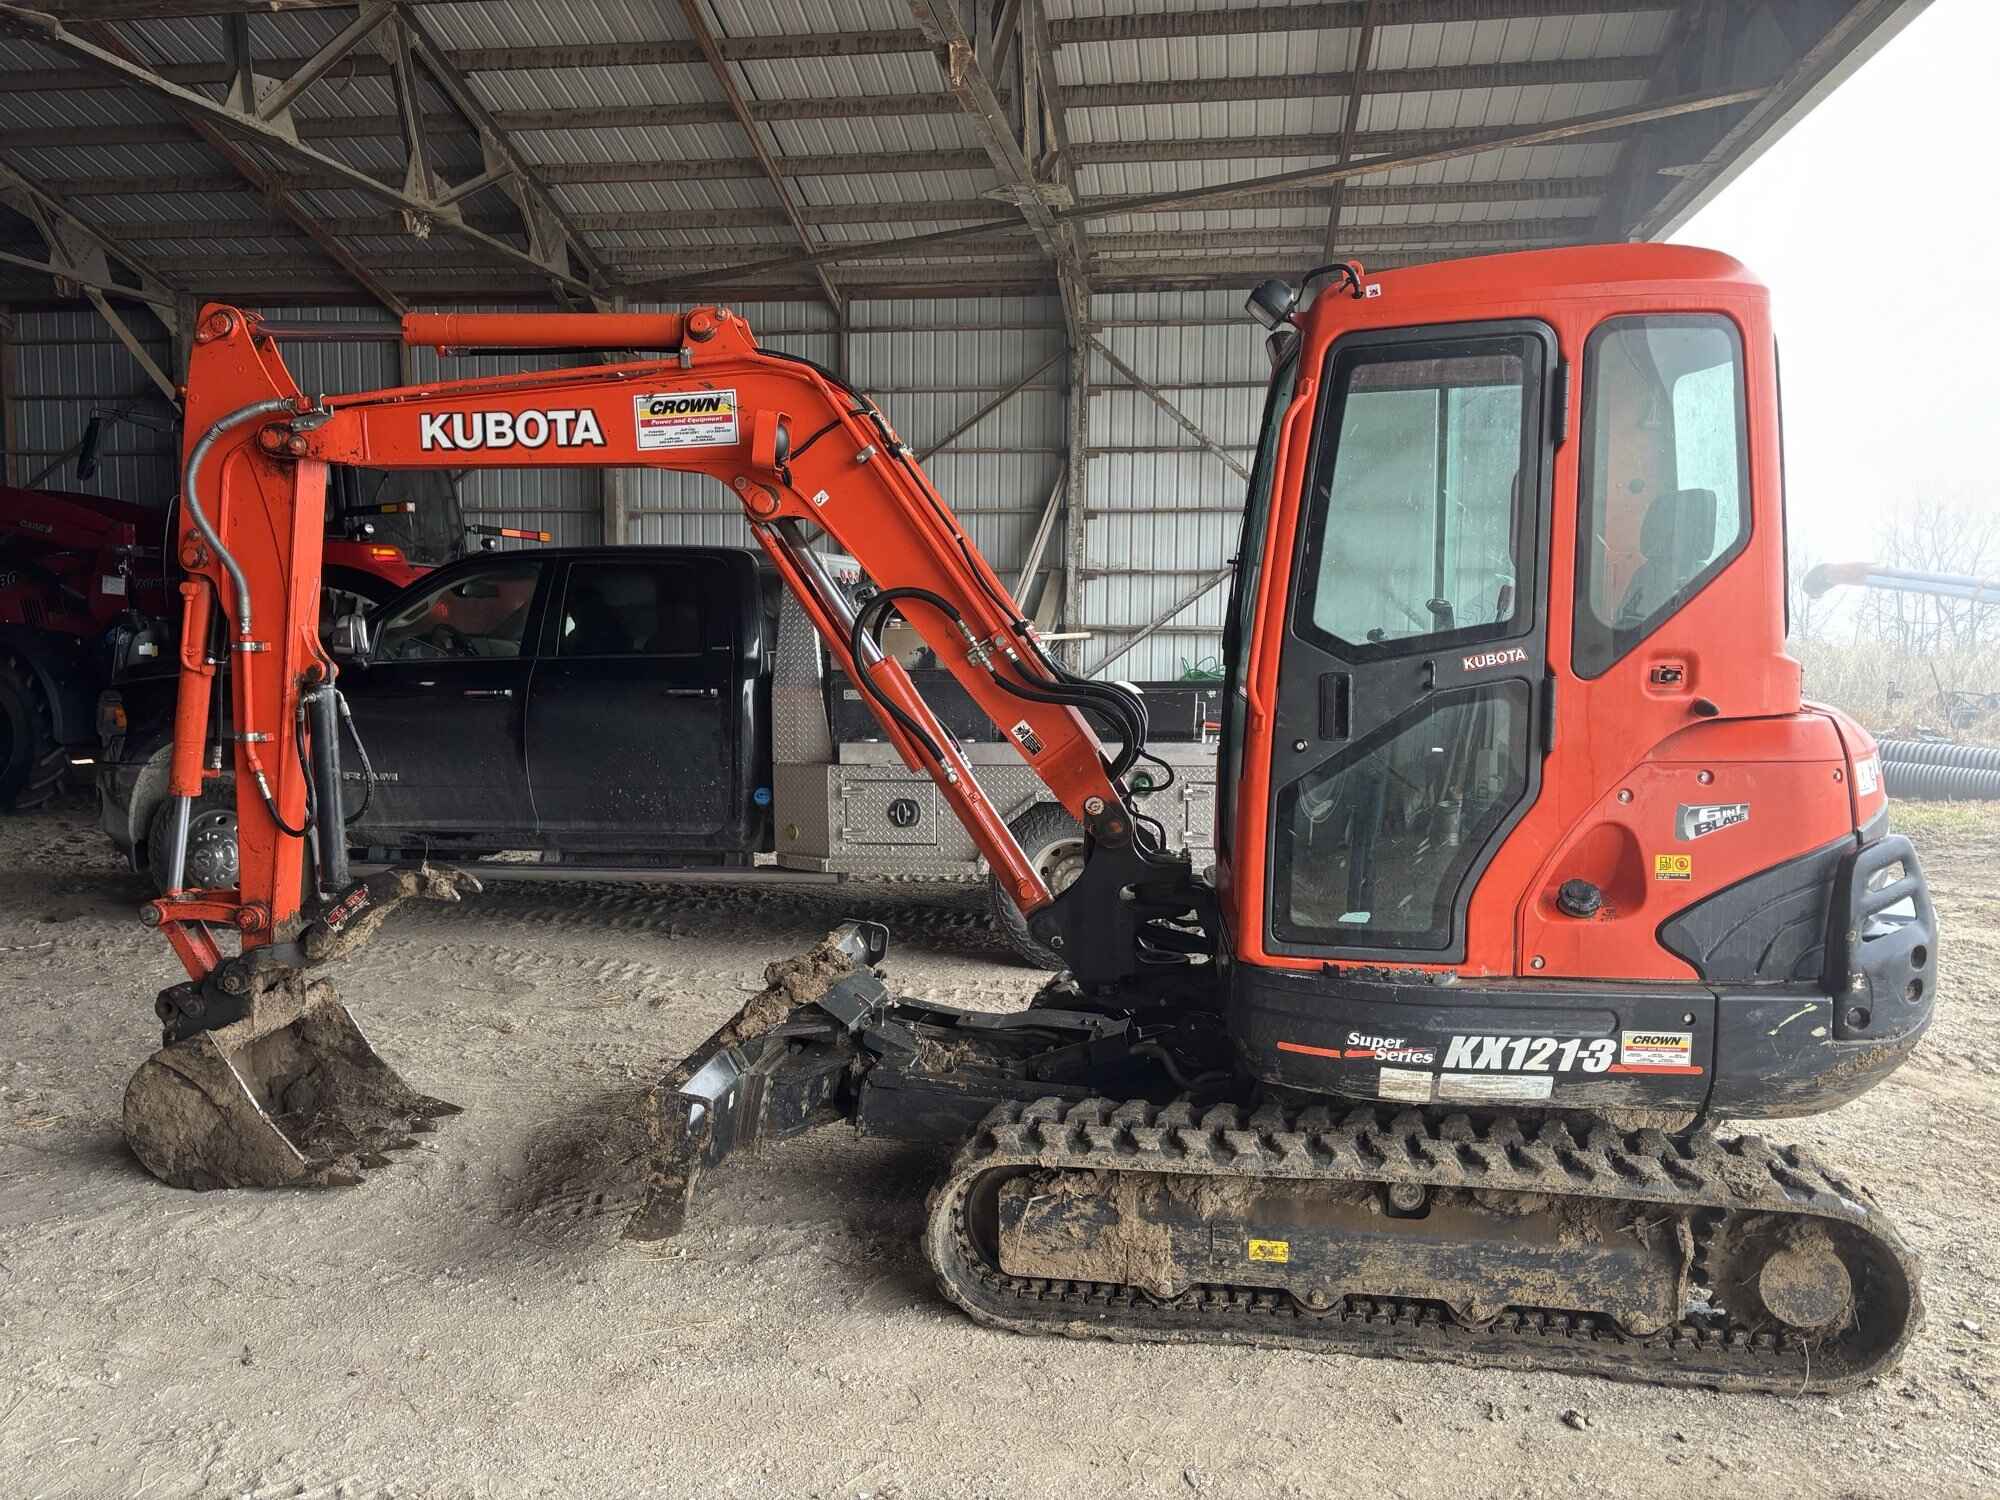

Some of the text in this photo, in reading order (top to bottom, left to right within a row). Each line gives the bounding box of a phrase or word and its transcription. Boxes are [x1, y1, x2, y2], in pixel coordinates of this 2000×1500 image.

[649, 397, 721, 416] CROWN
[419, 408, 606, 450] KUBOTA
[650, 418, 673, 426] Power
[687, 415, 723, 424] Equipment
[1463, 648, 1527, 670] KUBOTA
[1694, 813, 1746, 836] BLADE
[1699, 807, 1722, 823] 6
[1347, 1031, 1405, 1051] Super
[1632, 1035, 1682, 1046] CROWN
[1374, 1047, 1433, 1064] Series
[1442, 1036, 1617, 1073] KX121-3
